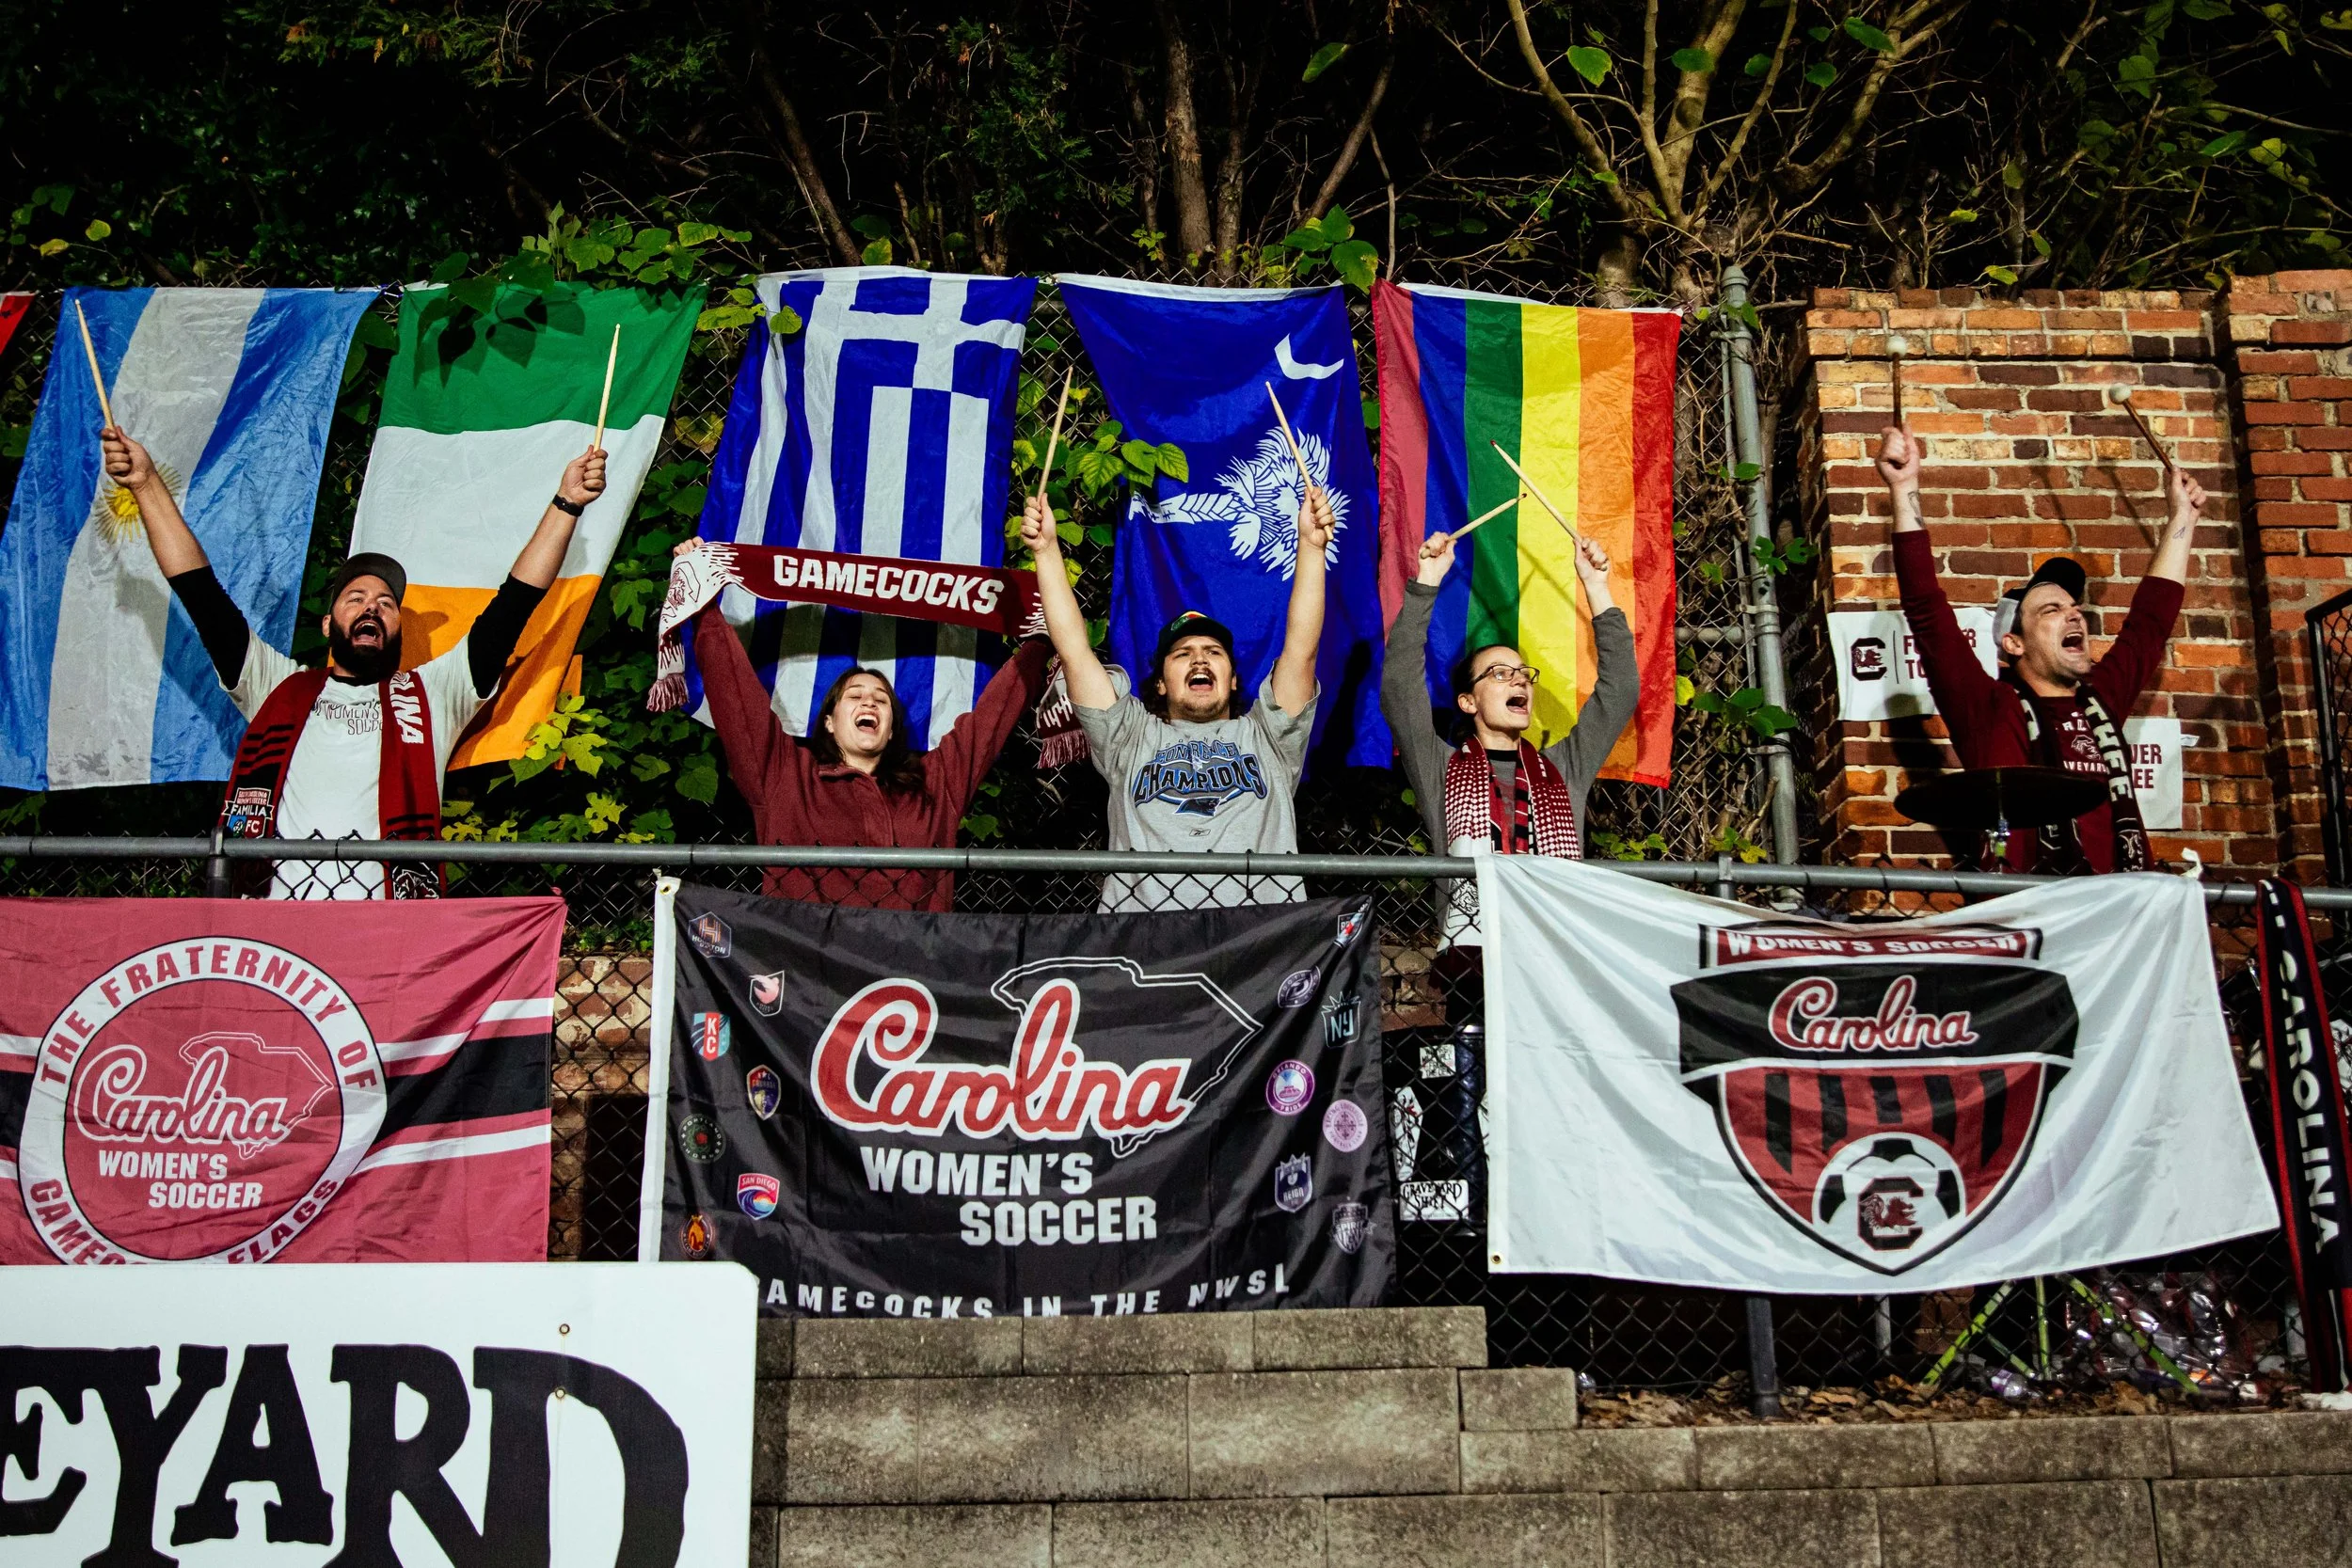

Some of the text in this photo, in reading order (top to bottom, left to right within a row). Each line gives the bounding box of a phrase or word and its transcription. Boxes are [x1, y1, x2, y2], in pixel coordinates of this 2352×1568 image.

[772, 554, 1005, 615] GAMECOCKS
[348, 719, 383, 735] SOCC
[389, 671, 424, 744] LINA
[2085, 696, 2134, 801] THEE
[1134, 755, 1266, 802] CHAMPIONS
[2134, 768, 2154, 789] EE
[230, 804, 266, 816] FAMILIA
[246, 820, 260, 832] FC
[1728, 930, 2020, 956] WOMEN'S SOCCER
[40, 944, 377, 1091] THE FRATERNITY OF
[707, 1018, 717, 1053] KC
[1330, 1008, 1355, 1042] NY
[1768, 974, 1979, 1052] Carolina
[811, 976, 1196, 1140] Carolina
[73, 1044, 291, 1145] Carolina
[2280, 950, 2341, 1254] CAROLINA
[99, 1150, 228, 1180] WOMEN'S
[741, 1177, 776, 1190] SAN DIEGO
[860, 1145, 1094, 1196] WOMEN'S
[149, 1182, 263, 1209] SOCCER
[227, 1179, 339, 1265] FLAGS
[959, 1196, 1158, 1246] SOCCER
[767, 1262, 1290, 1319] AMECOCKS IN THE NWSL
[0, 1343, 690, 1568] EYARD
